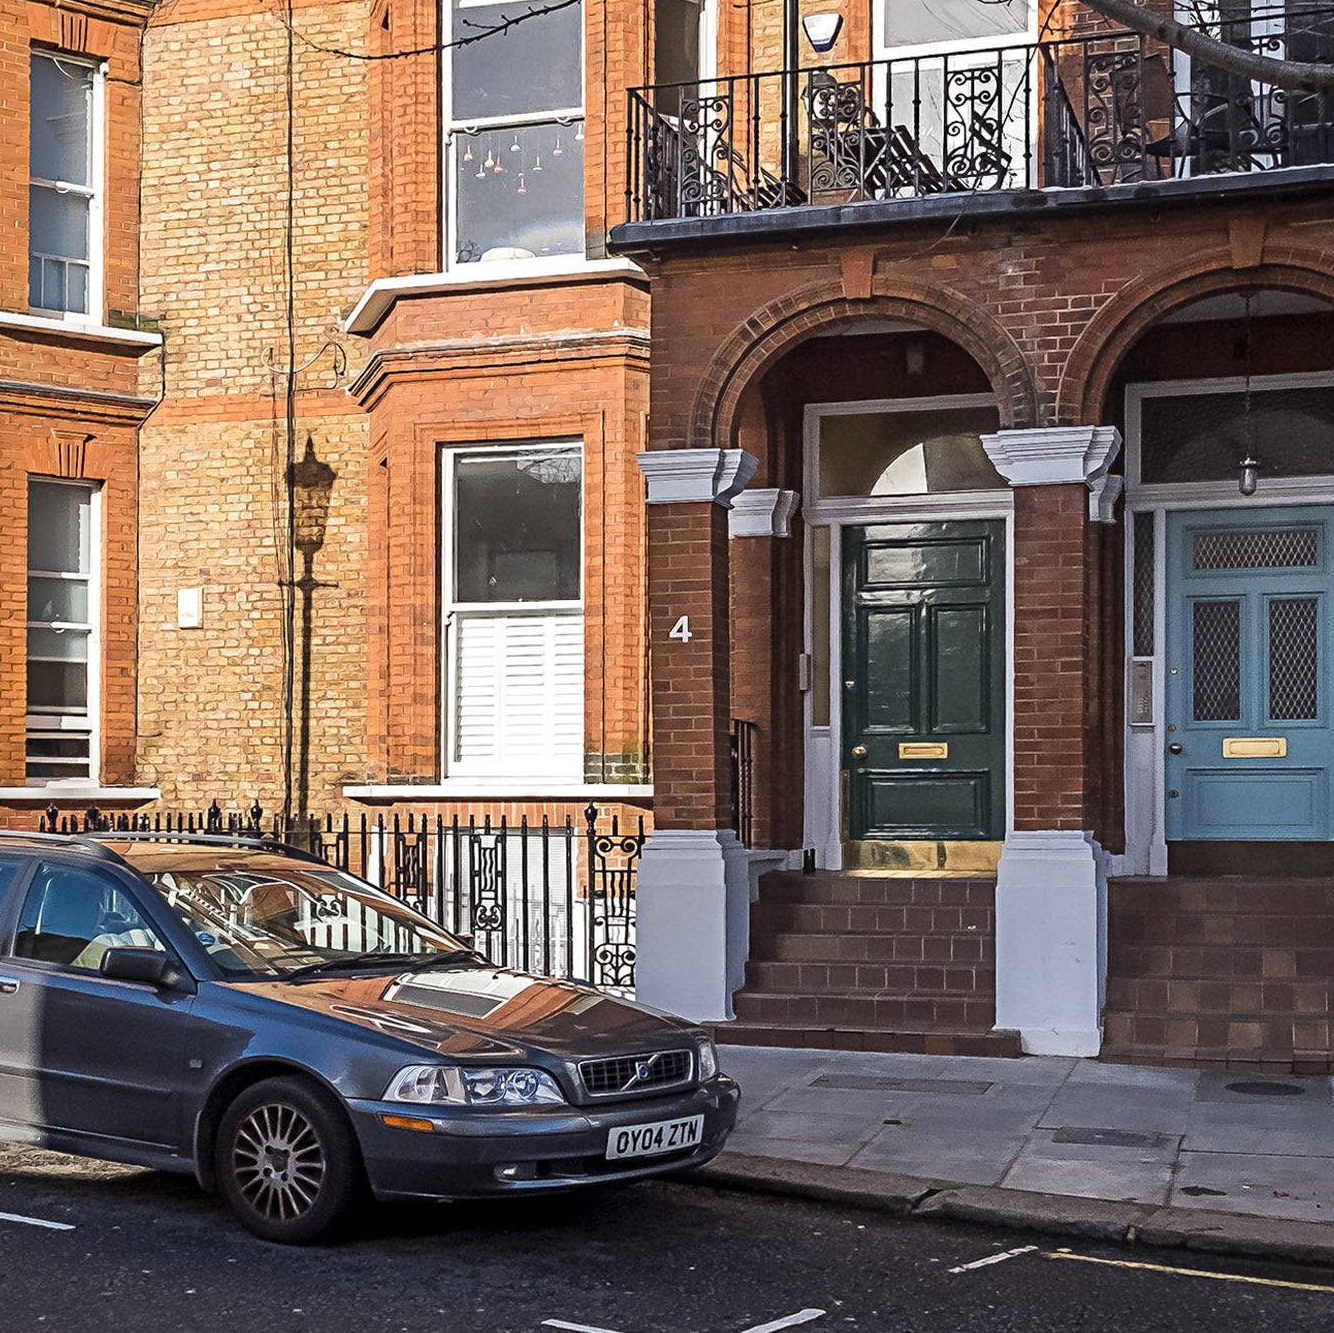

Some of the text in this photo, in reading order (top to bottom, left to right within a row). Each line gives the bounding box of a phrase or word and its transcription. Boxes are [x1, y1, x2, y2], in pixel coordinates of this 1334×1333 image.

[669, 614, 693, 643] 4
[617, 1119, 699, 1154] OY04 ZTN
